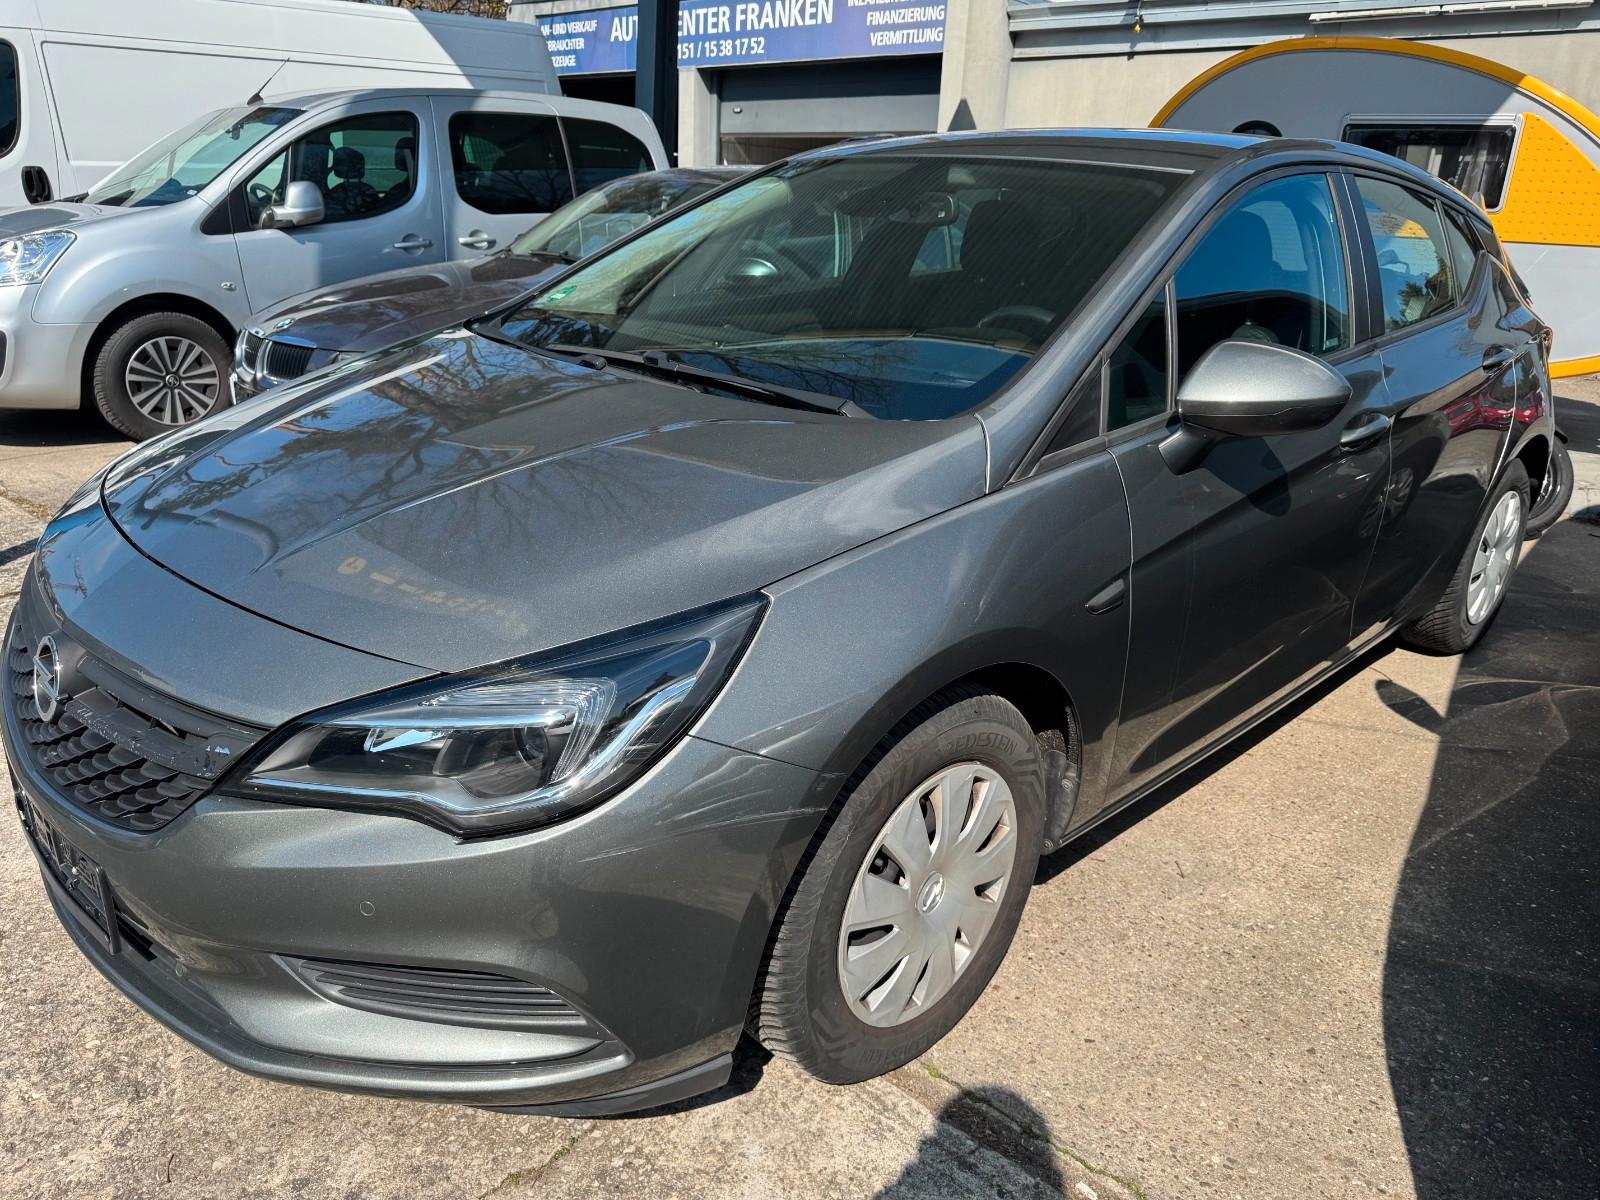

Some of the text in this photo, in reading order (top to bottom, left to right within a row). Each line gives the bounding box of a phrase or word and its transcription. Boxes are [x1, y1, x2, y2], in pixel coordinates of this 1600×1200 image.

[735, 0, 834, 31] FRANKEN
[866, 5, 945, 26] FINANZIERUNG
[552, 22, 567, 35] UND
[567, 19, 598, 33] VERKAUF
[870, 27, 944, 46] VERMITTLUNG
[546, 38, 585, 52] BRAUCHTER
[677, 37, 765, 59] 151 / 15 38 17 52
